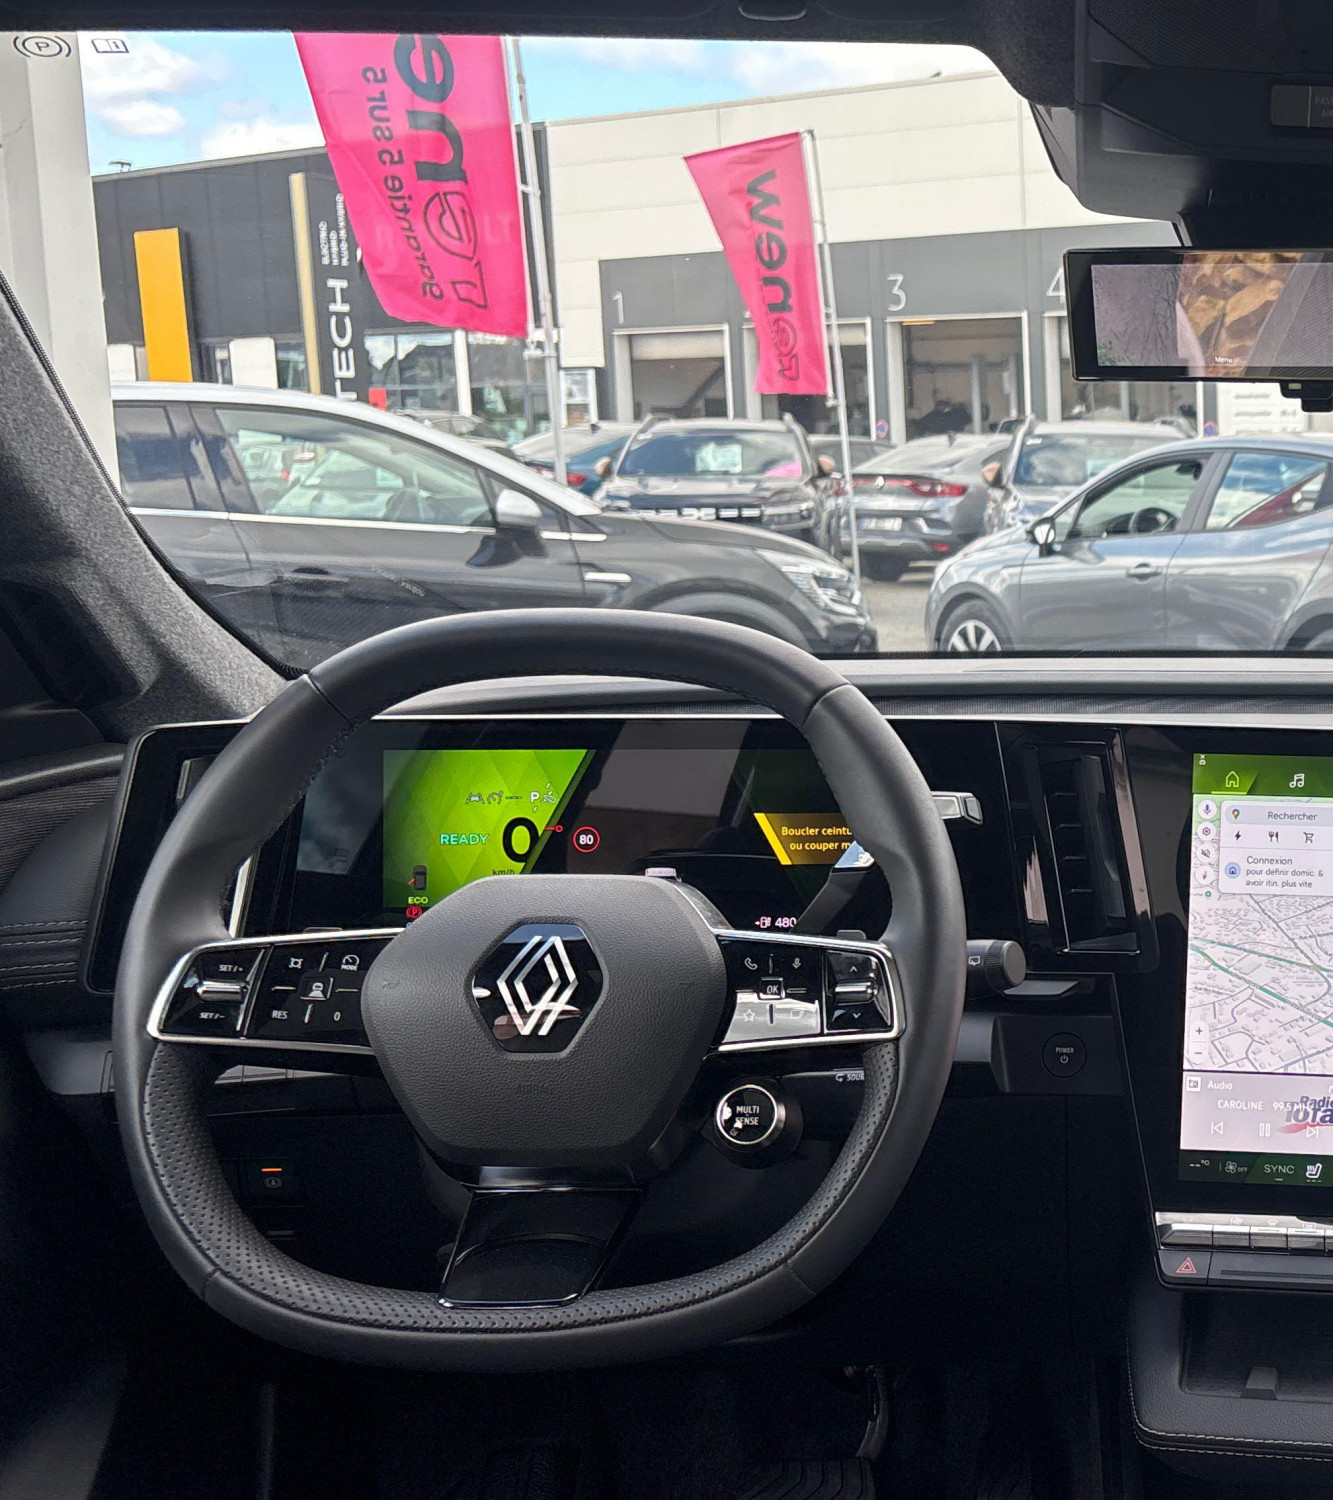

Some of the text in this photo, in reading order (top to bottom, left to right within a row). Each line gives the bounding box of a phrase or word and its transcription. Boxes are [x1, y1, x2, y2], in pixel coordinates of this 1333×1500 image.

[1046, 266, 1067, 303] 4
[886, 273, 907, 312] 3
[612, 291, 624, 325] 1
[530, 791, 540, 803] P
[1267, 811, 1318, 821] Rechercher
[781, 826, 819, 836] Boucler
[440, 816, 540, 863] READY 0
[578, 834, 594, 845] 80
[789, 842, 803, 850] ou
[805, 842, 840, 851] couper
[1246, 856, 1293, 866] Connexion
[1246, 868, 1264, 878] pour
[1290, 868, 1316, 878] domic.
[1317, 869, 1324, 878] &
[1246, 880, 1264, 888] avoir
[1281, 880, 1298, 889] plus
[1299, 880, 1313, 889] vite
[407, 896, 429, 904] ECO
[774, 917, 797, 928] 480
[766, 985, 779, 994] OK
[271, 1010, 288, 1020] RES
[1207, 1081, 1233, 1090] Audio
[736, 1105, 760, 1114] MULTI
[1217, 1100, 1264, 1111] CAROLINE
[735, 1117, 760, 1126] SENSE
[1263, 1164, 1295, 1174] SYNC
